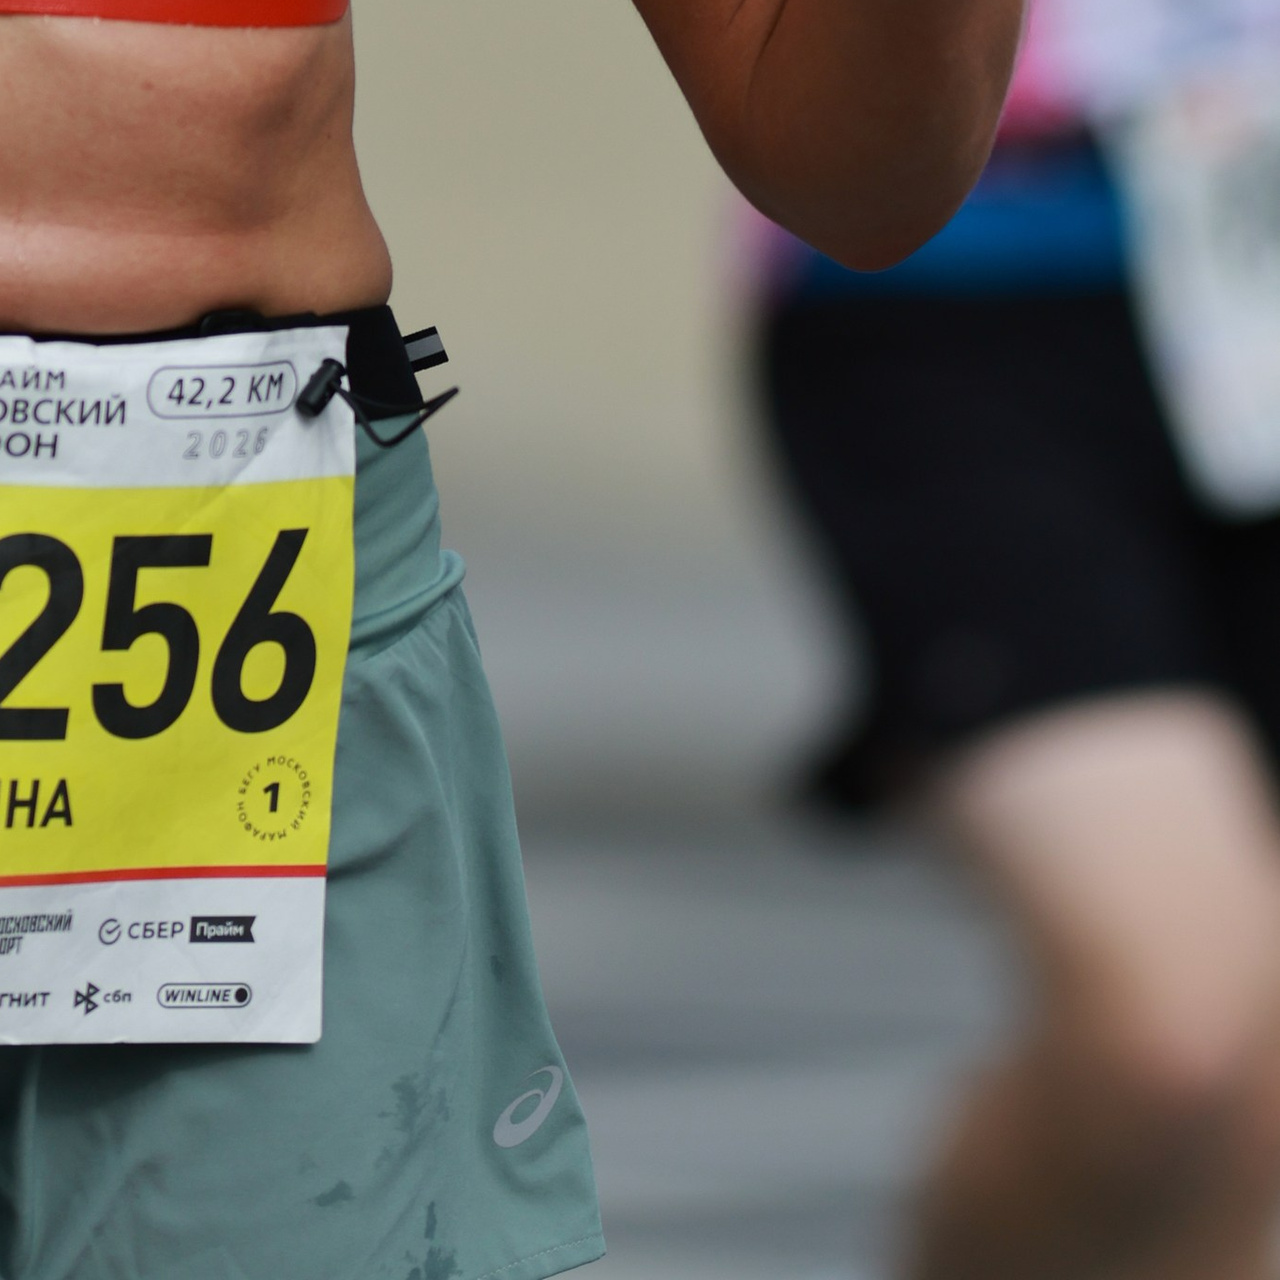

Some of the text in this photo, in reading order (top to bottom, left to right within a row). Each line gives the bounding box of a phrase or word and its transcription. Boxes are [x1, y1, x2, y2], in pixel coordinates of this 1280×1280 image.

[167, 372, 285, 409] 42,2 КМ
[182, 426, 269, 460] 2026
[263, 781, 280, 813] 1
[127, 920, 245, 940] СБЕР Прайм
[164, 989, 232, 1003] WINLINE
